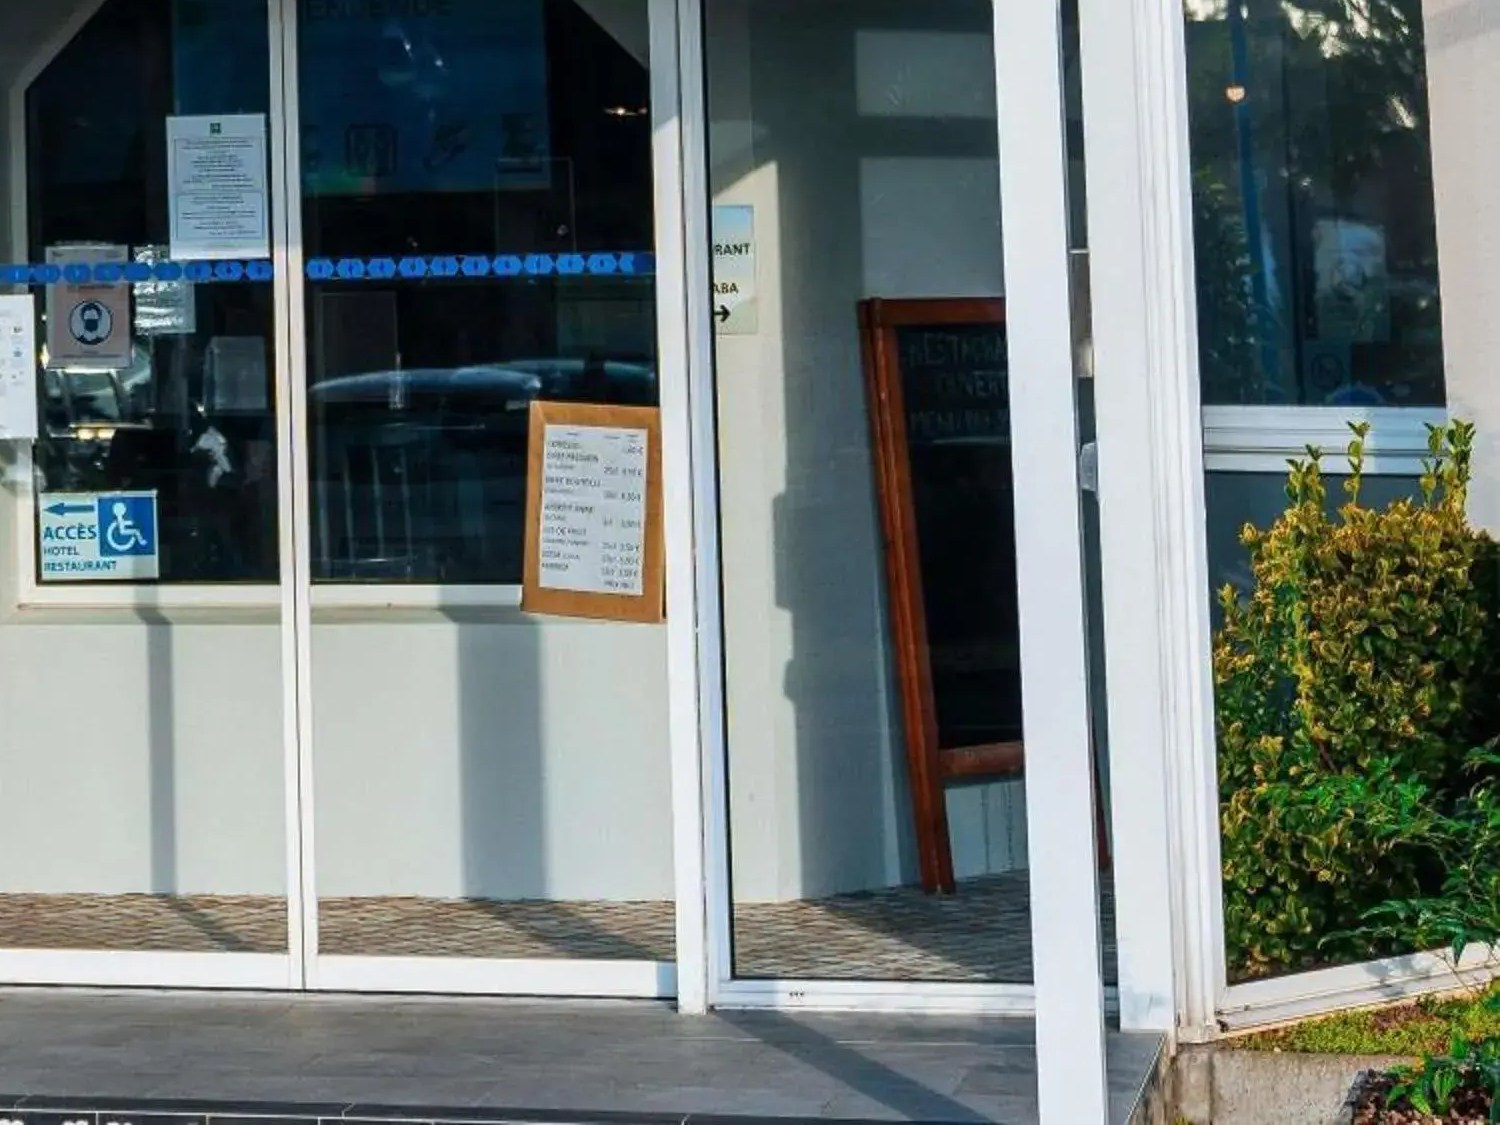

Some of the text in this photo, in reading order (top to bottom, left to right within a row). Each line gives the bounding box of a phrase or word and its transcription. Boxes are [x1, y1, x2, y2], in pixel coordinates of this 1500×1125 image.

[43, 522, 98, 540] ACCÈS
[44, 545, 80, 556] HOTEL
[44, 560, 118, 572] RESTAURANT
